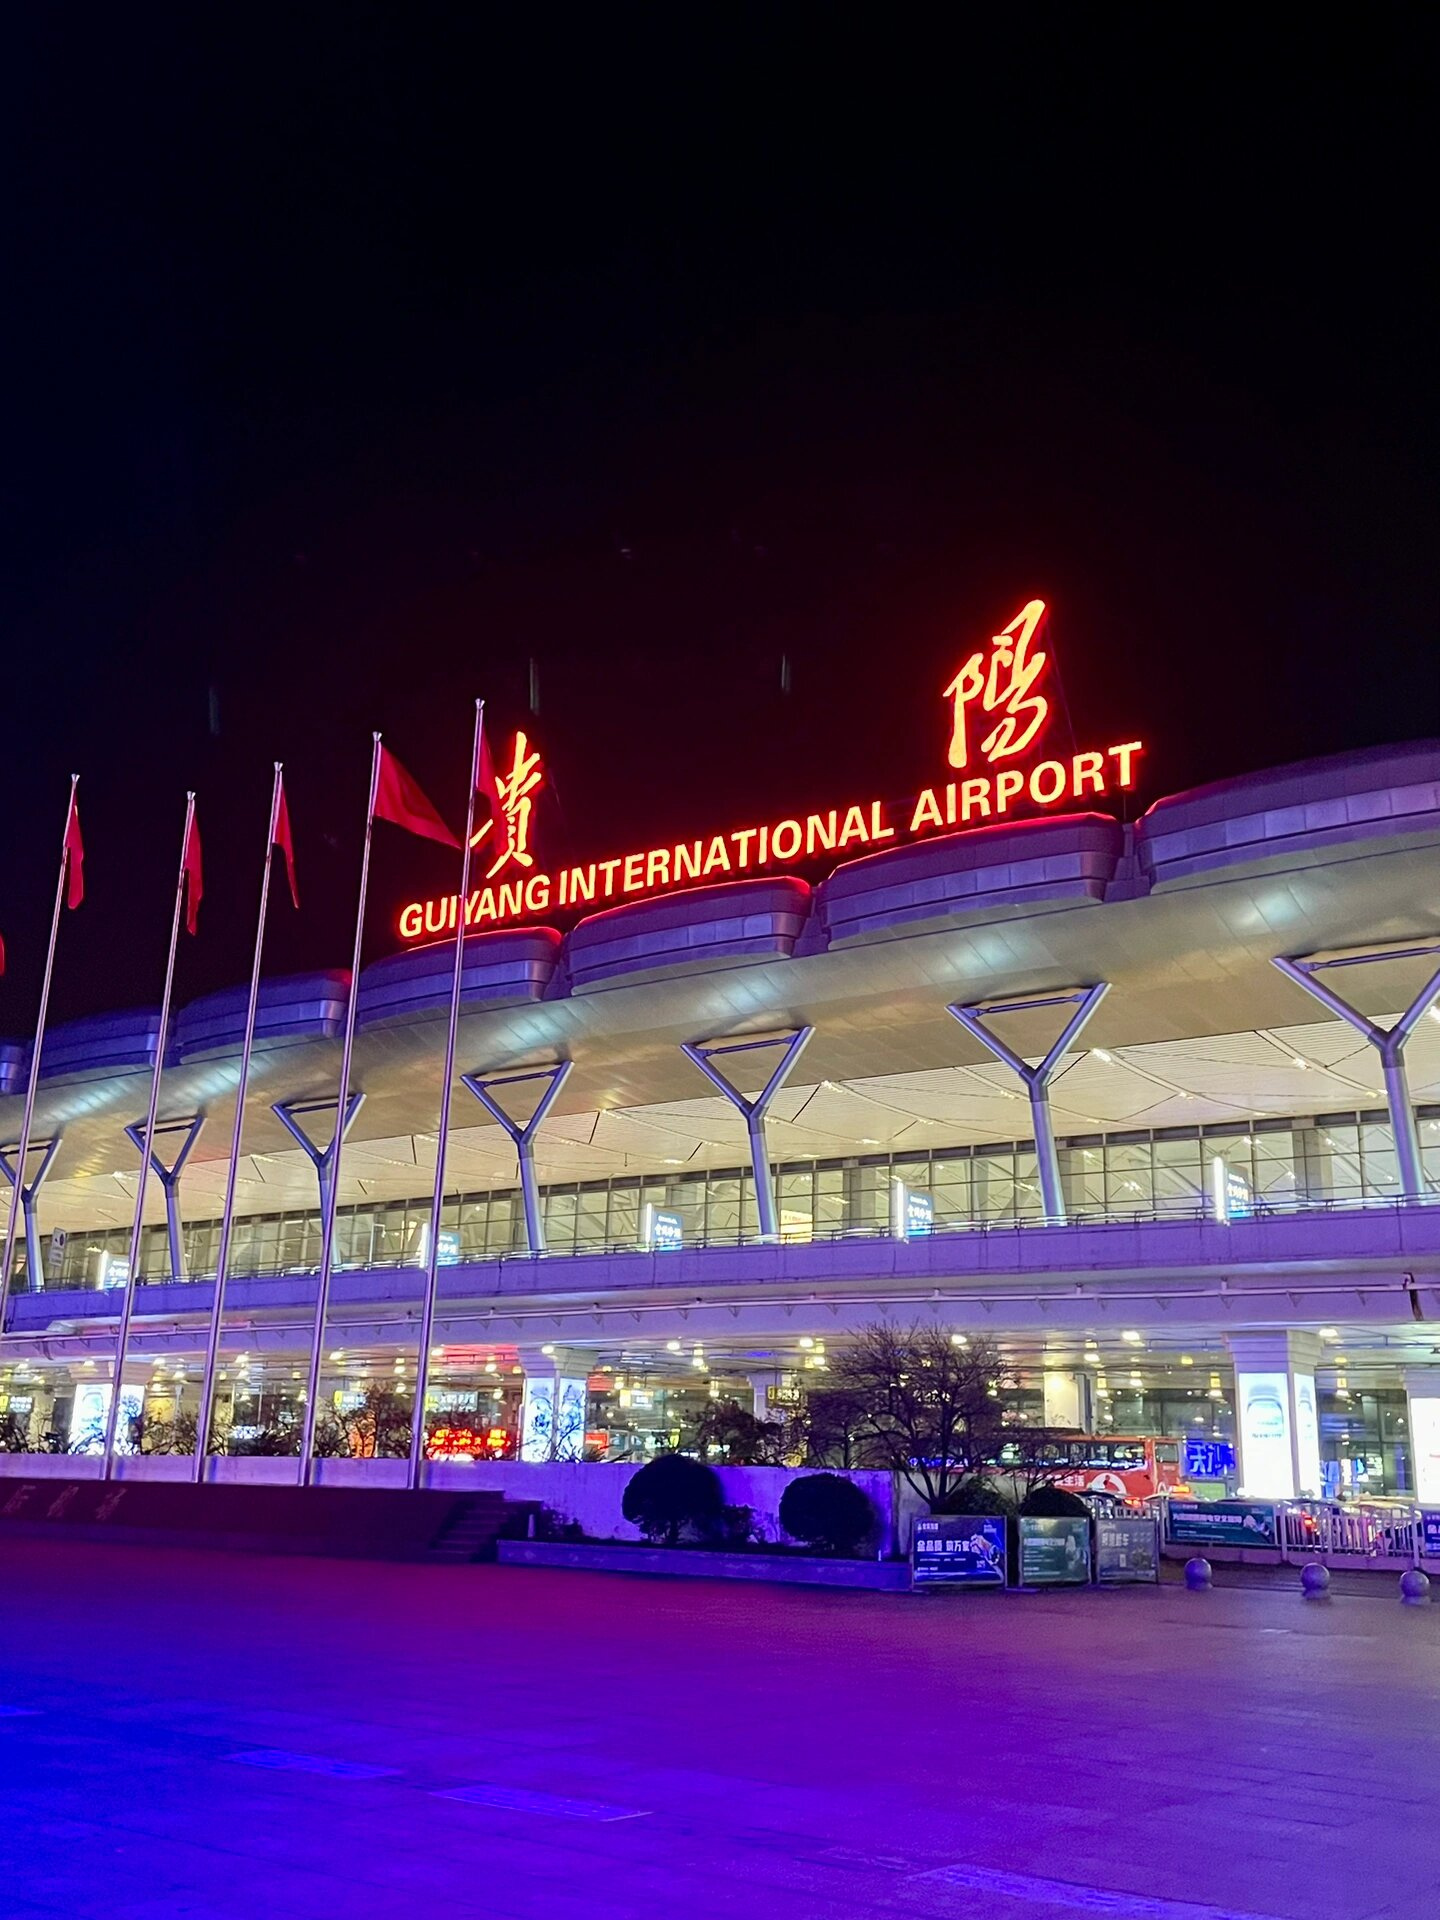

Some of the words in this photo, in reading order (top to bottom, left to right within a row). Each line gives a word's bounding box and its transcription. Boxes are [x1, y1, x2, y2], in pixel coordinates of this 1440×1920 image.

[399, 875, 550, 937] GUIYANG
[559, 801, 895, 905] INTERNATIONAL
[909, 741, 1142, 832] AIRPORT
